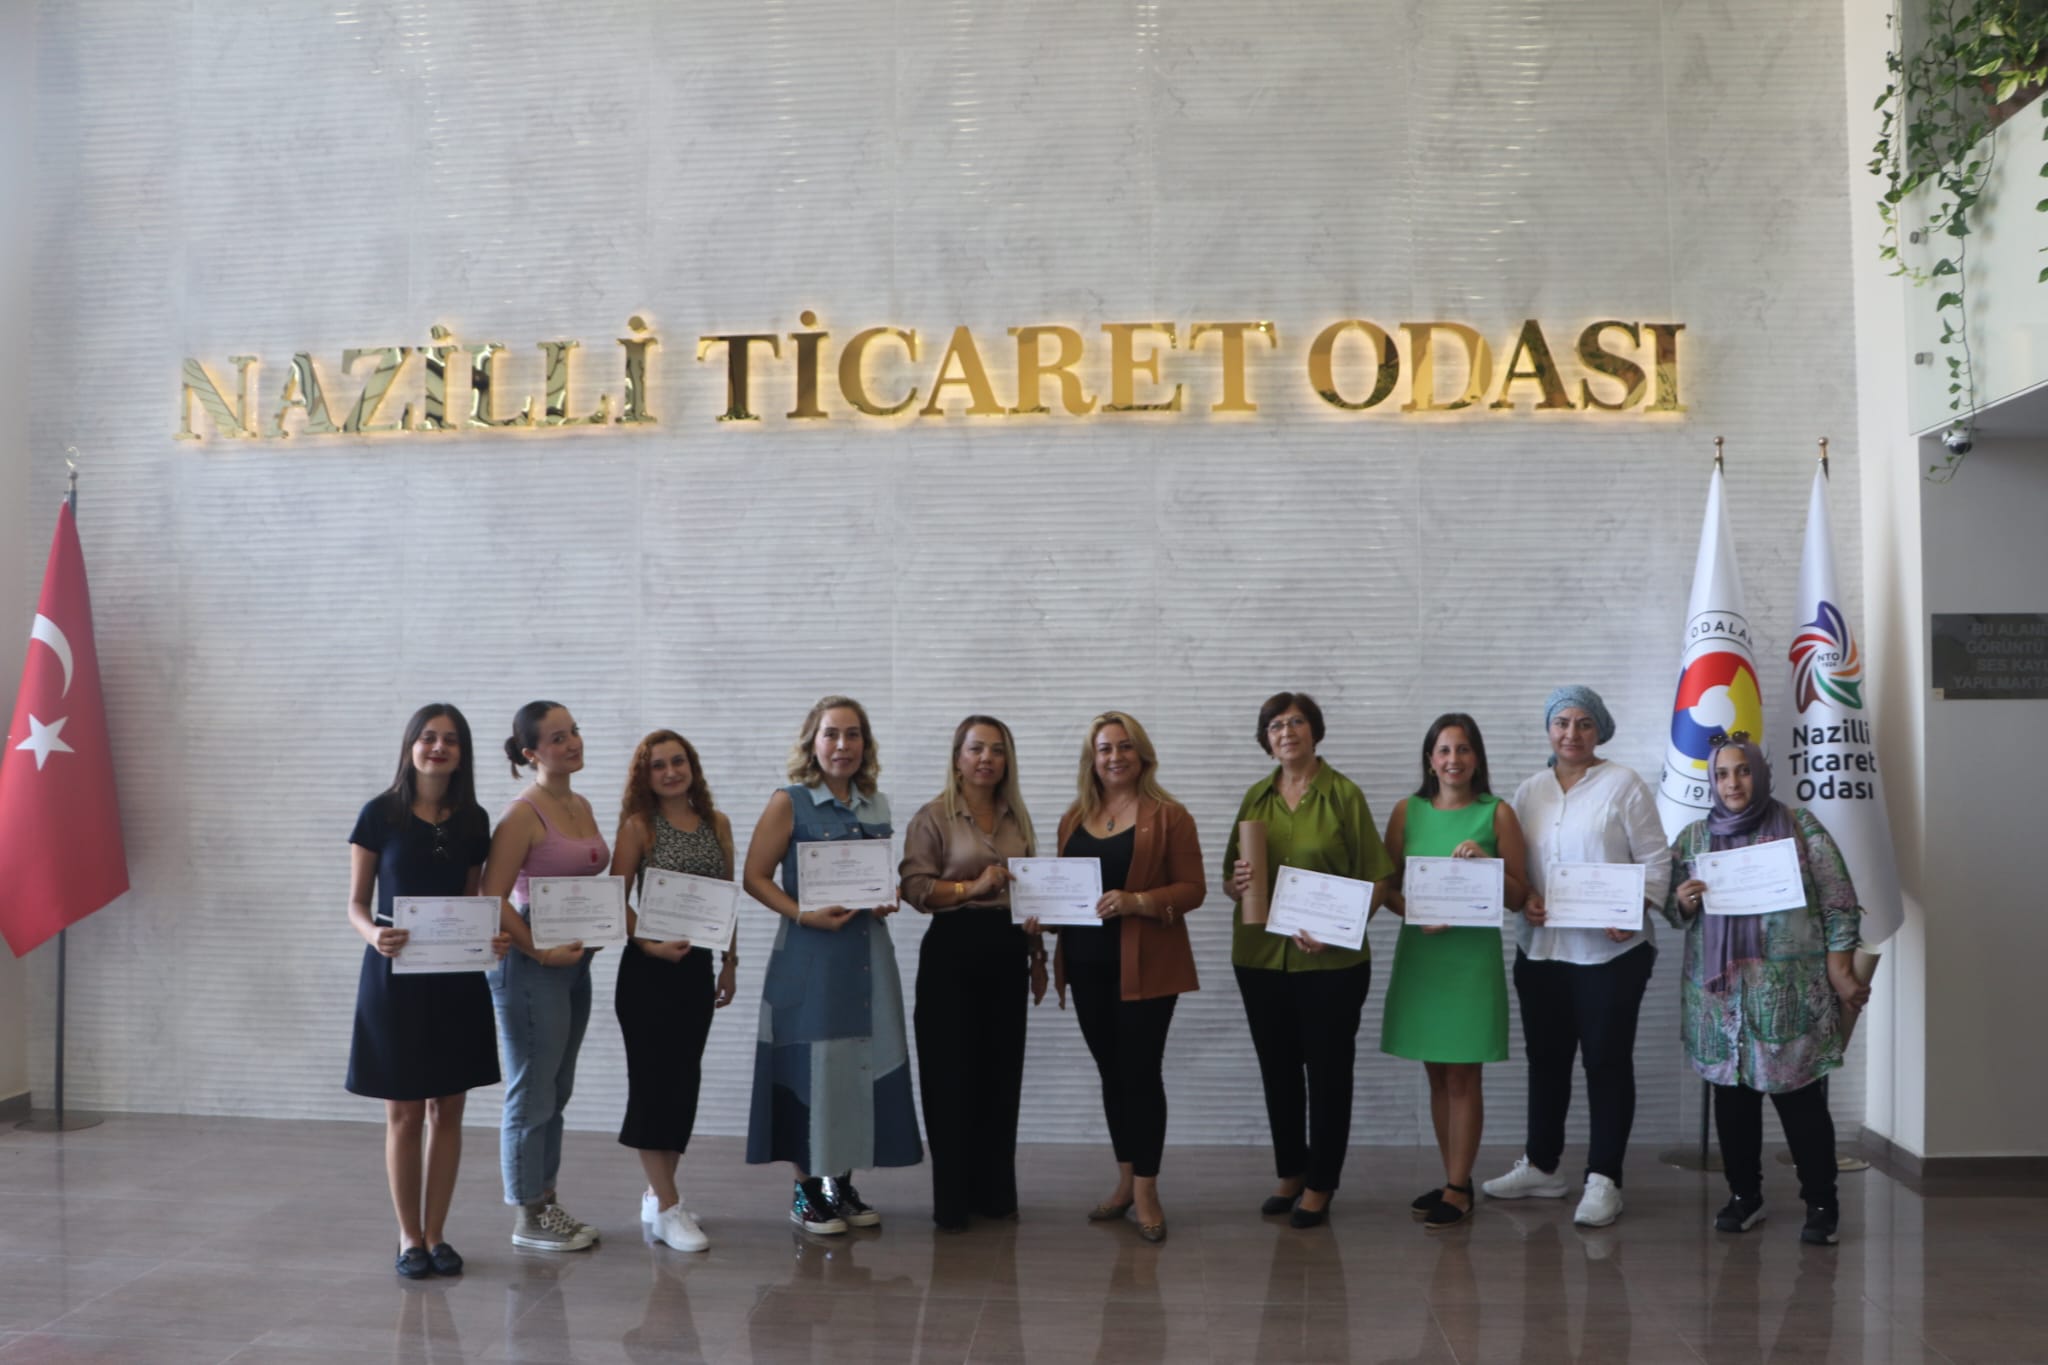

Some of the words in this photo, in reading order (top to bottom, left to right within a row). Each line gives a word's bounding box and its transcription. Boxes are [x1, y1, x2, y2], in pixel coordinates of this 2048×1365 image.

[173, 315, 659, 440] NAZİLLİ
[696, 310, 1278, 422] TİCARET
[1307, 318, 1687, 413] ODASI
[1817, 652, 1840, 662] NTO
[1792, 718, 1870, 748] Nazilli
[1788, 750, 1877, 776] Ticaret
[1796, 774, 1874, 802] Odası
